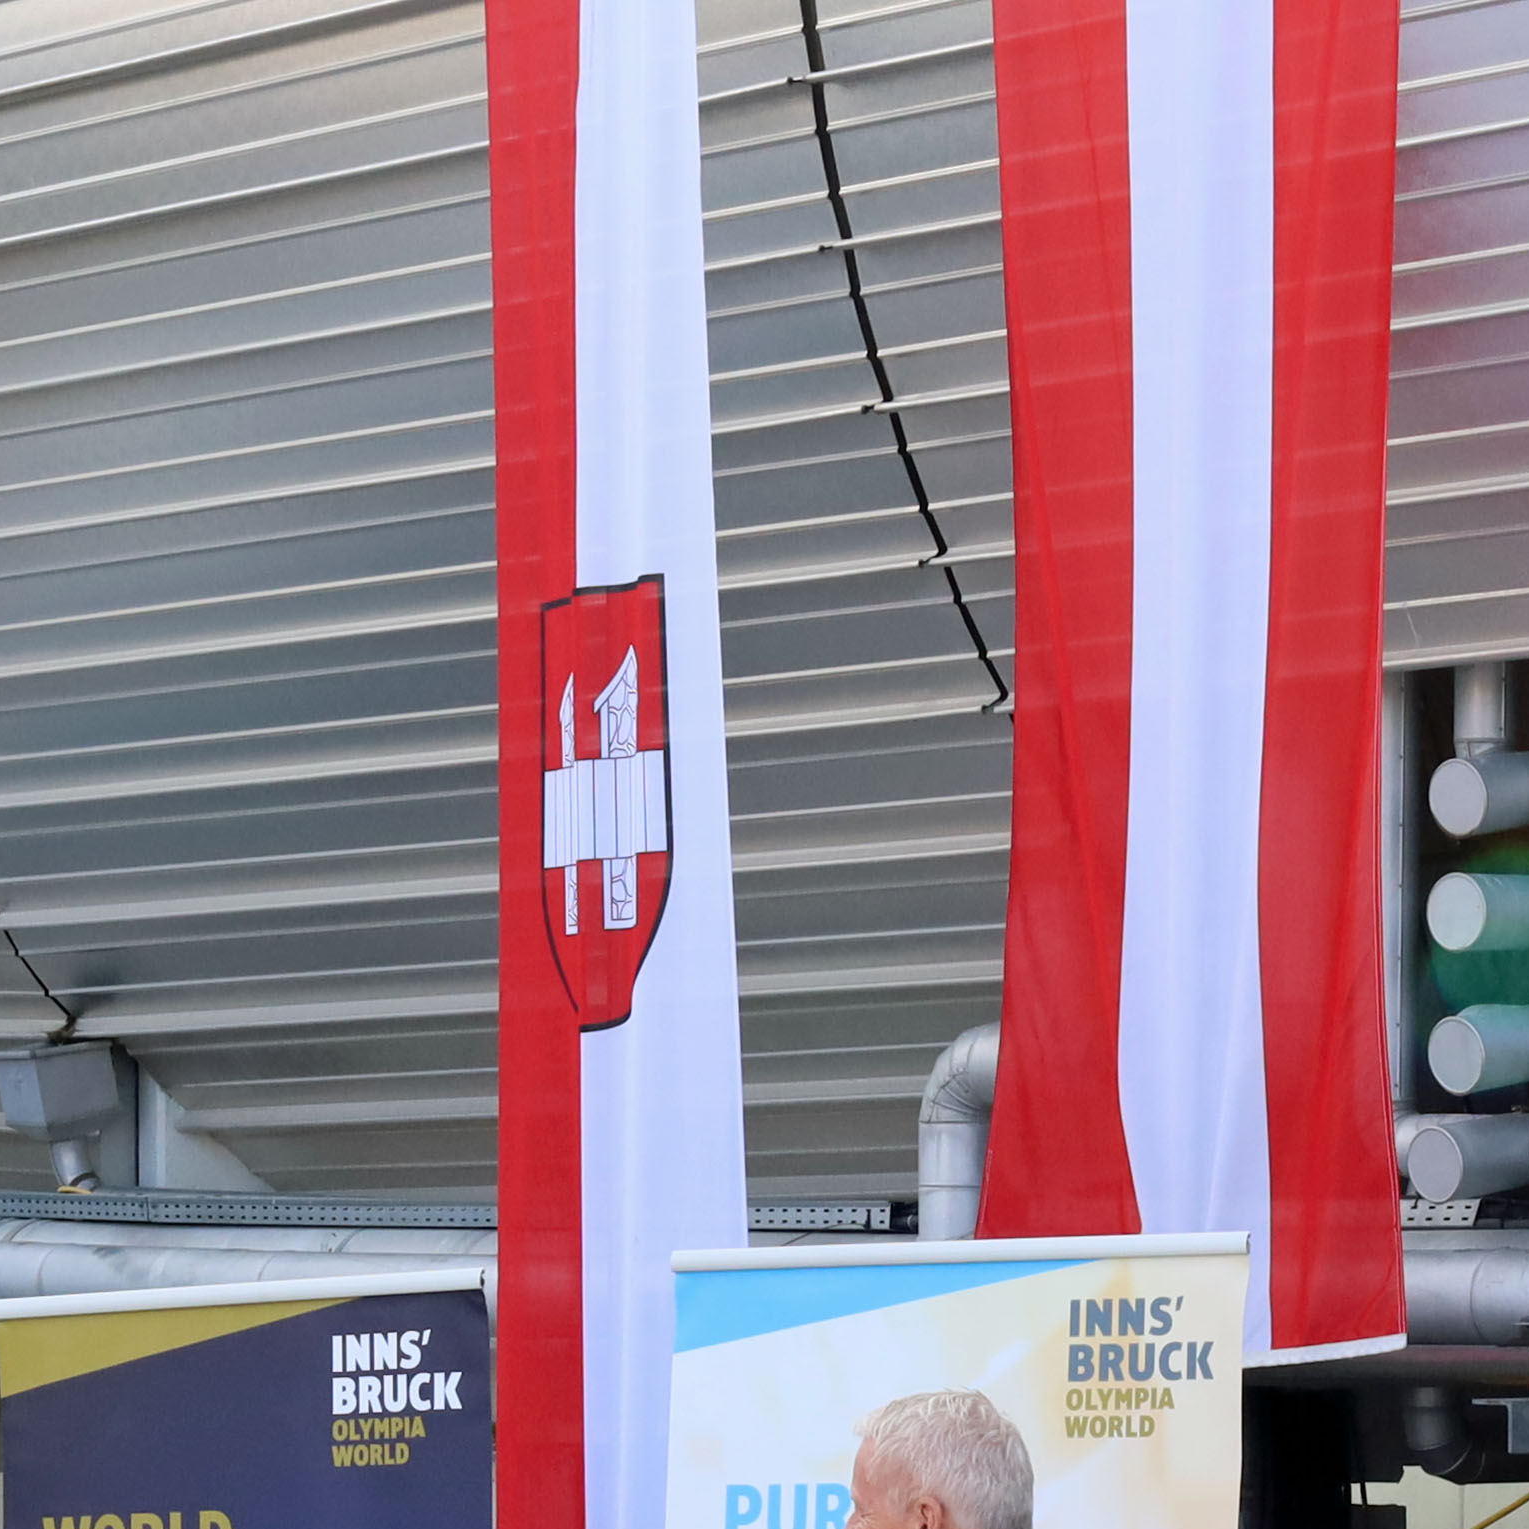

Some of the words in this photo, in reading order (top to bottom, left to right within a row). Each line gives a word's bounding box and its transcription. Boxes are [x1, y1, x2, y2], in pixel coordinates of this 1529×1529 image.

[1069, 1296, 1183, 1338] INNS'
[331, 1329, 431, 1373] INNS'
[1067, 1341, 1214, 1383] BRUCK
[331, 1371, 462, 1415] BRUCK
[1065, 1386, 1175, 1412] OLYMPIA
[331, 1416, 426, 1442] OLYMPIA
[1064, 1416, 1155, 1439] WORLD
[331, 1443, 409, 1468] WORLD
